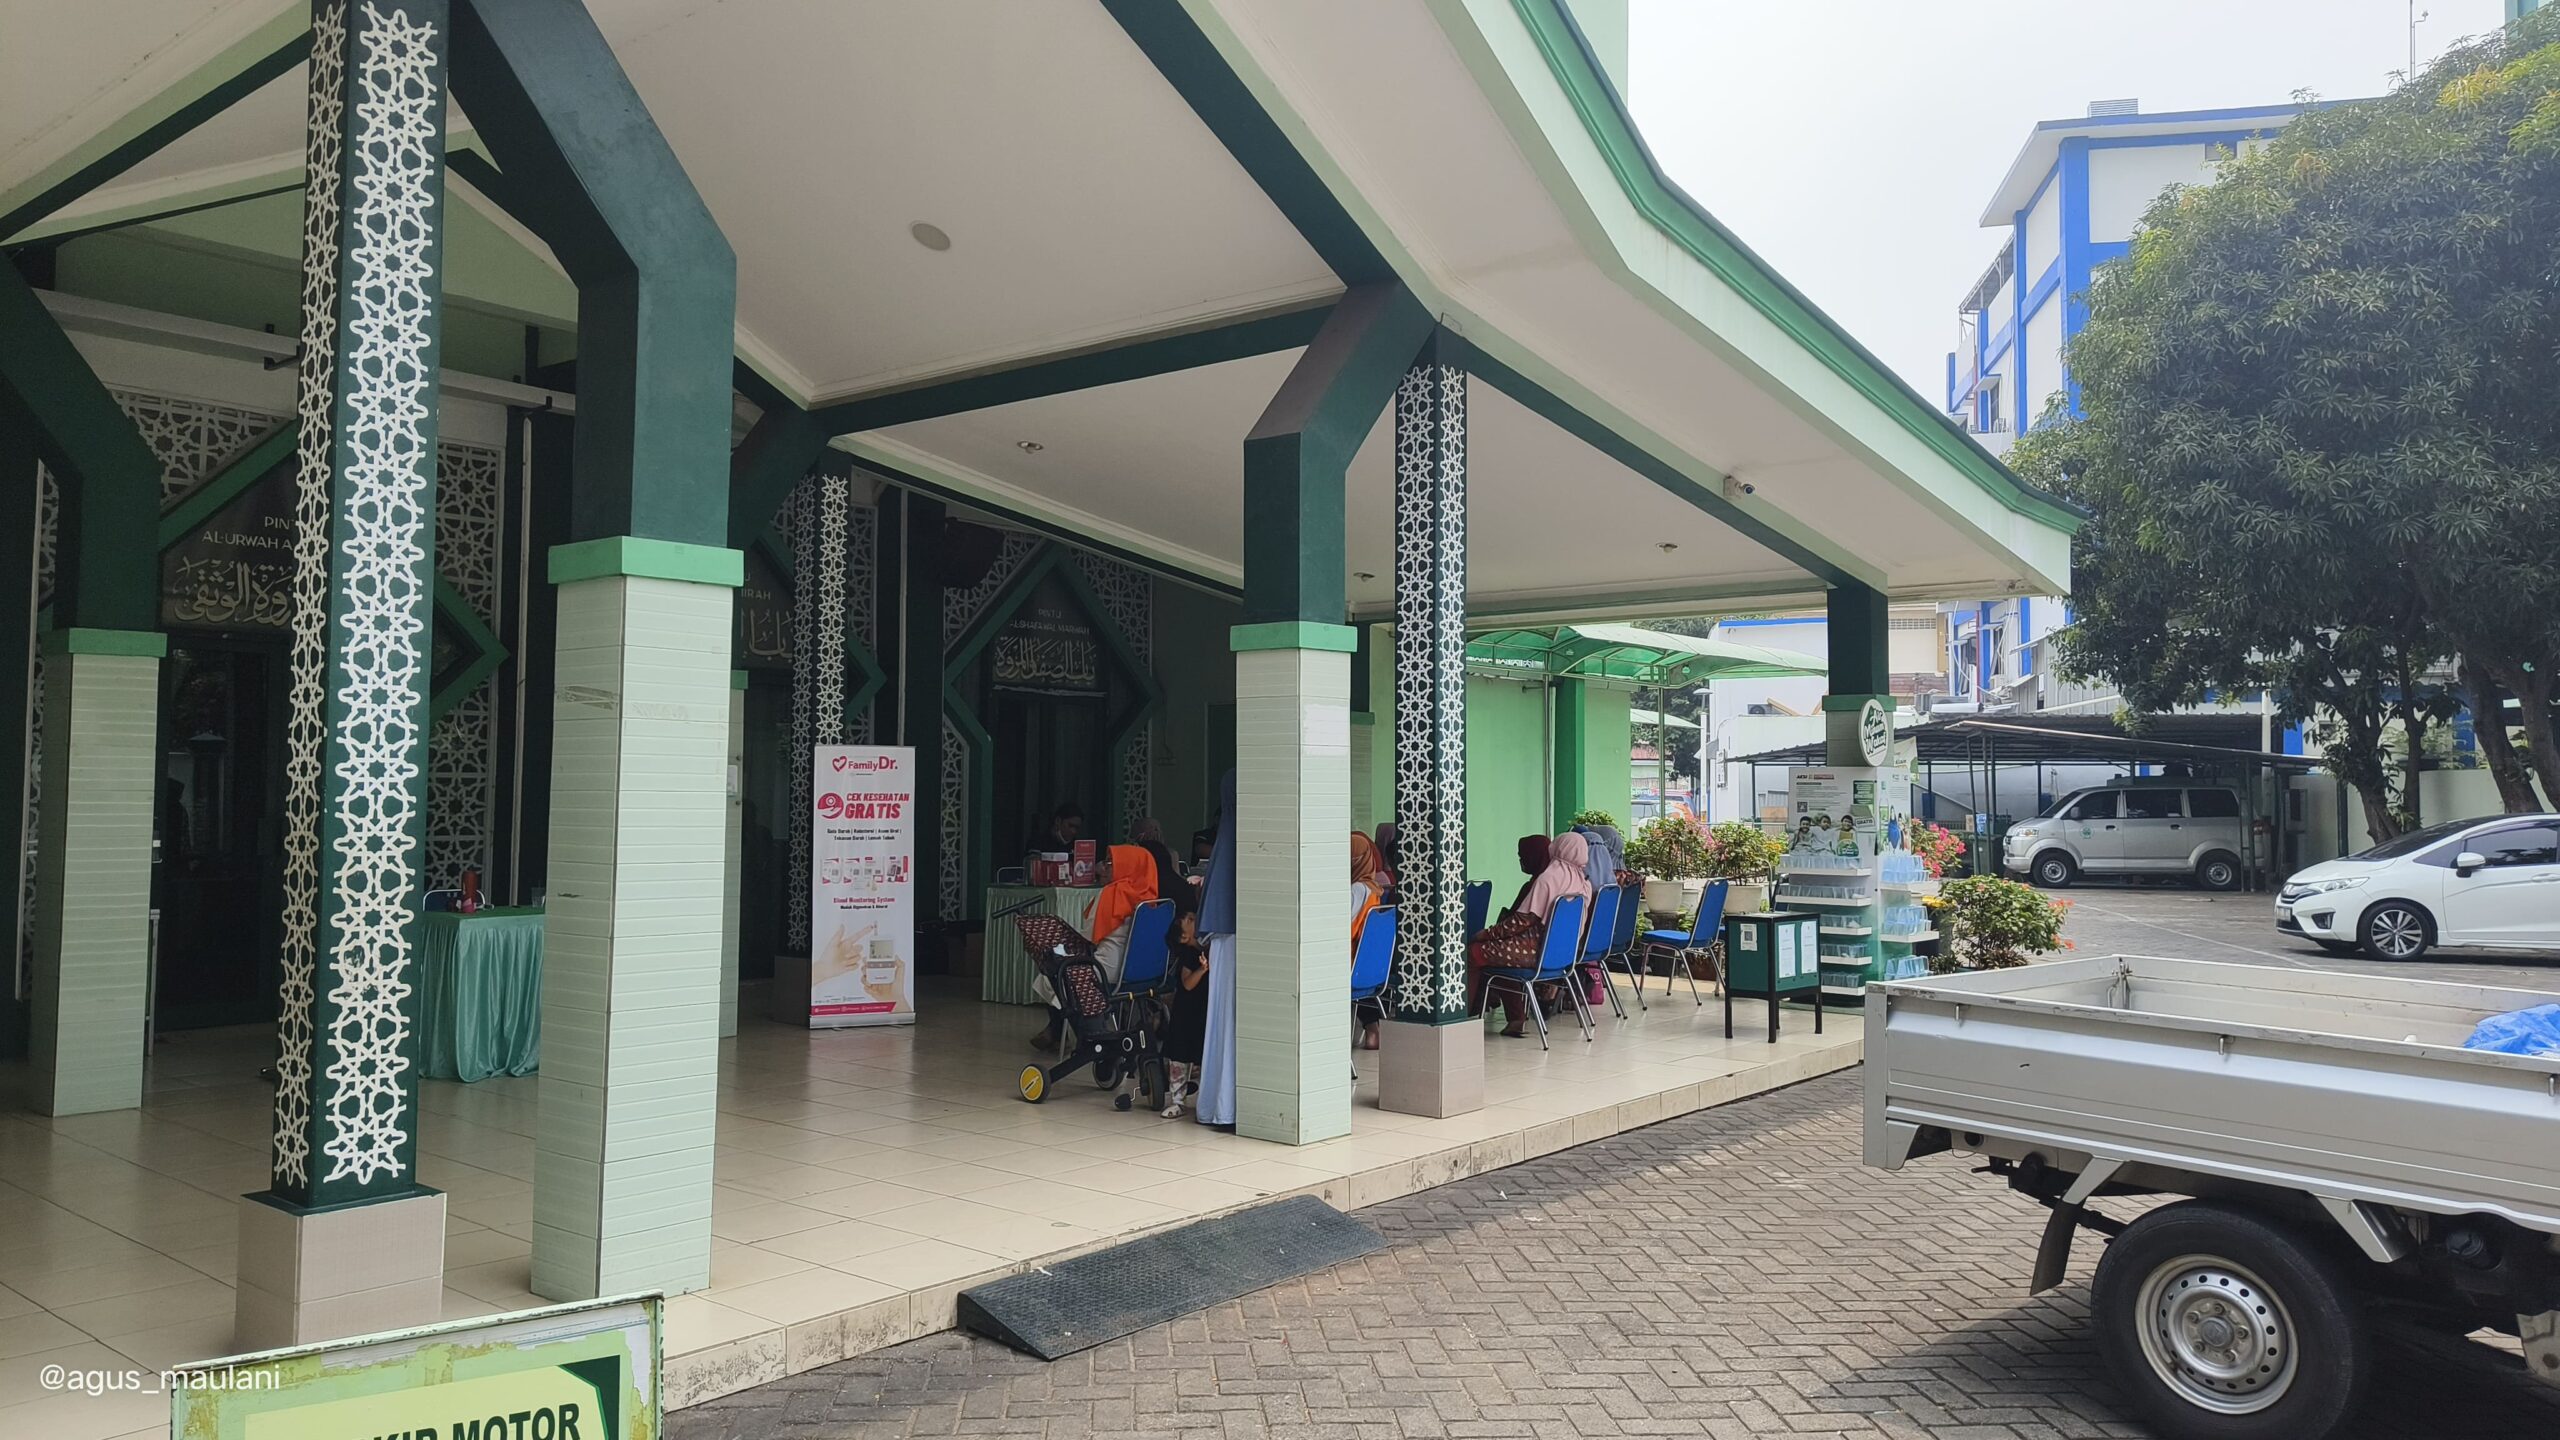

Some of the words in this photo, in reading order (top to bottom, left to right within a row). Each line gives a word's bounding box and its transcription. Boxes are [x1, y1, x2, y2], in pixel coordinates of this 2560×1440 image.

[263, 516, 294, 530] PIN
[846, 793, 862, 802] CEK
[863, 793, 910, 802] KESEHATAN
[845, 803, 901, 819] GRATIS
